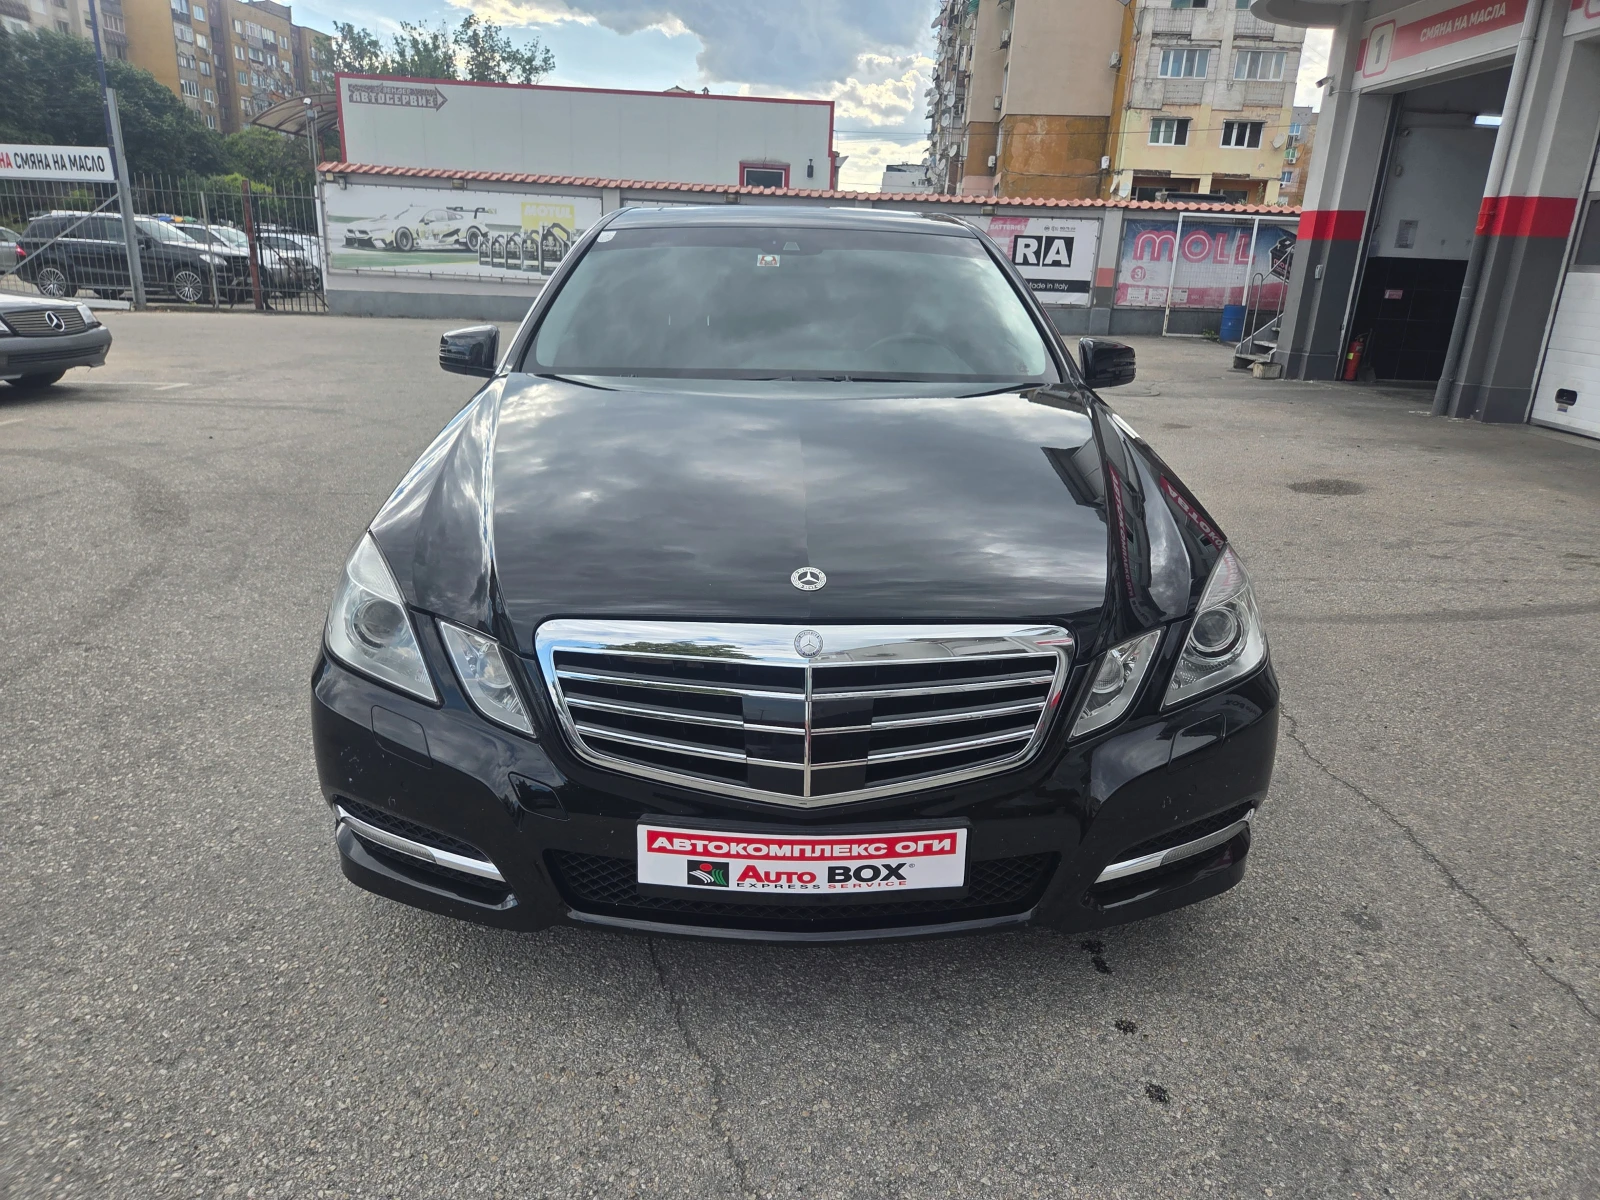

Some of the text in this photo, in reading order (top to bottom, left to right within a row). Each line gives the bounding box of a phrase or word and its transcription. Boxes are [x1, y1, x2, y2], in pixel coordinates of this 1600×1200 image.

[1420, 2, 1506, 42] СМЯНА НА МАСЛА
[1375, 35, 1386, 65] 1
[352, 92, 434, 107] АВТОСЕРВИЗ
[14, 152, 51, 170] СМЯНА
[52, 153, 68, 171] НА
[68, 154, 105, 172] МАСЛО
[524, 204, 573, 218] MOTUL
[1015, 237, 1070, 265] RA
[1054, 283, 1069, 291] Italy
[651, 836, 951, 857] АВТОКОМПЛЕКС ОГИ
[737, 862, 908, 884] AUTO BOX
[736, 880, 907, 890] EXPRESS SERVICE
